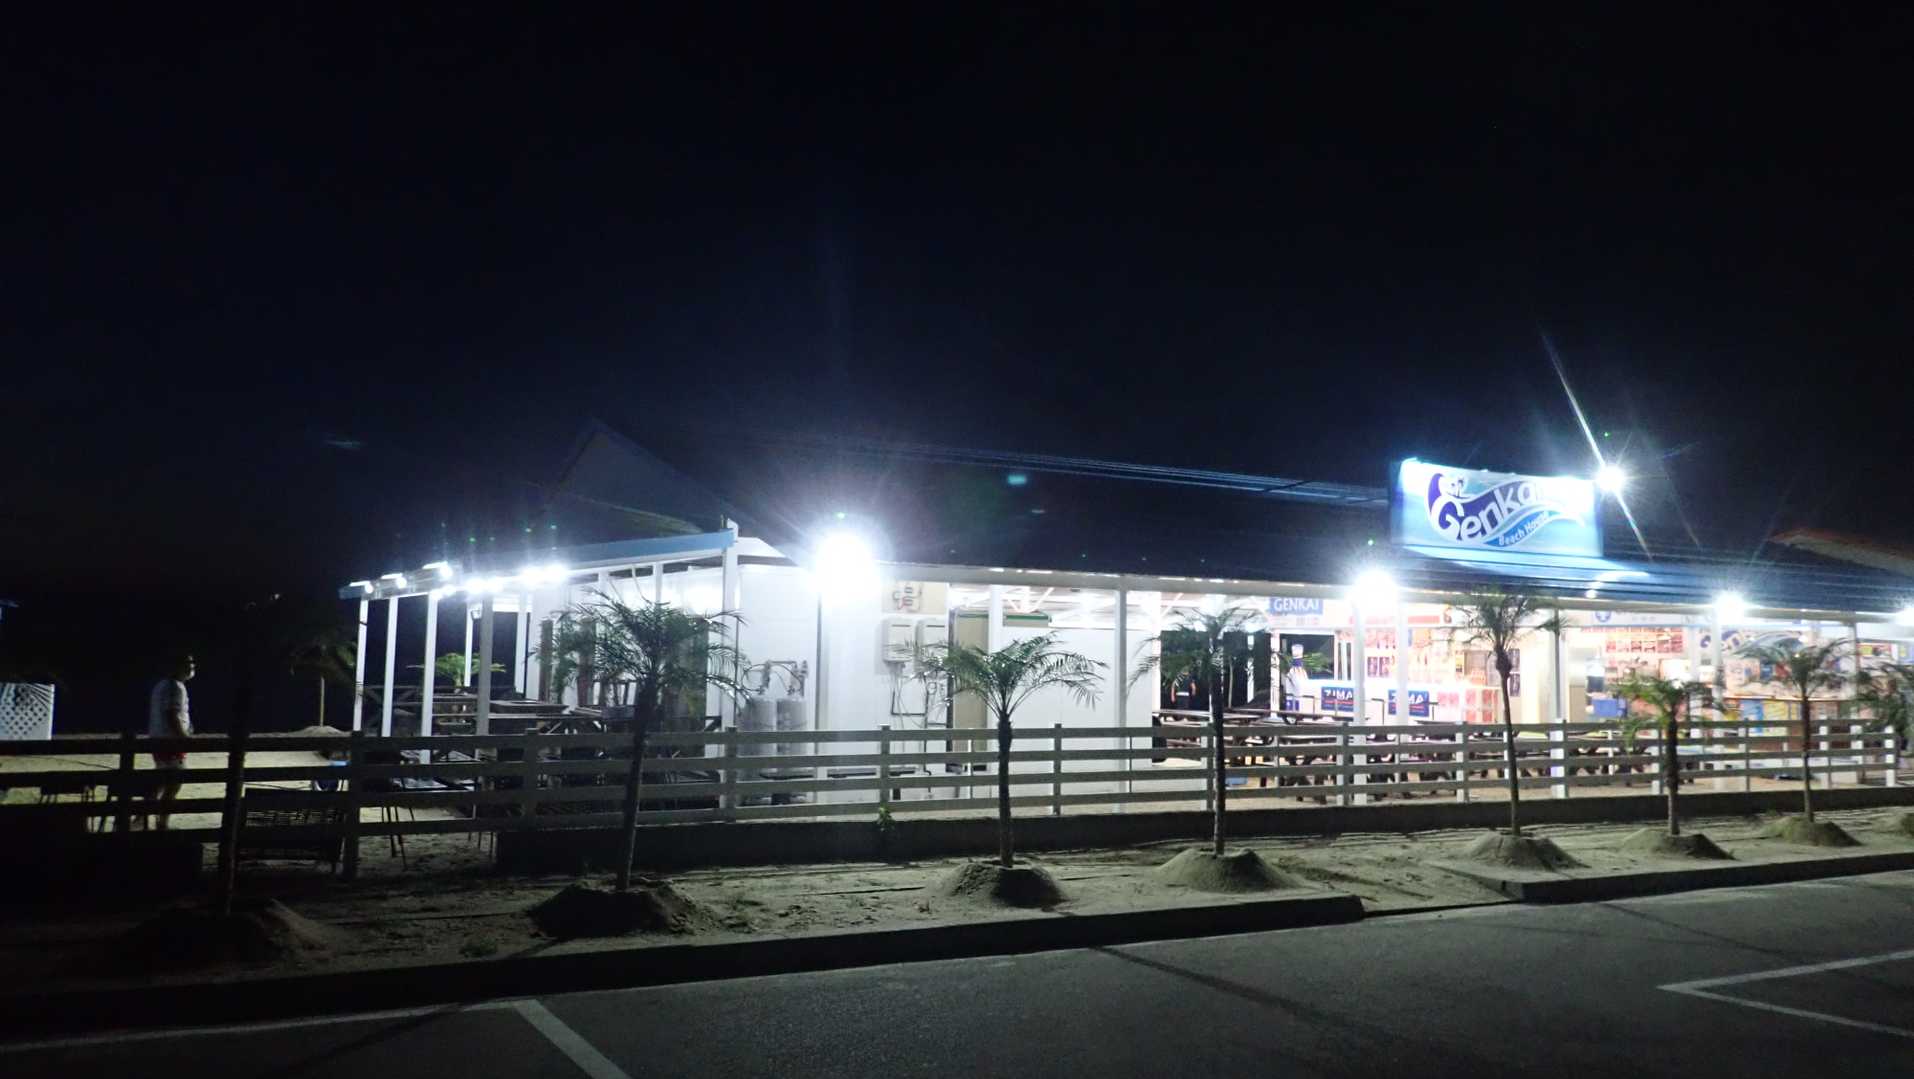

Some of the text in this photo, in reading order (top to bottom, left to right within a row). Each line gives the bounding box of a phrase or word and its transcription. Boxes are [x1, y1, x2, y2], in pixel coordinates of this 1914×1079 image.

[1431, 482, 1546, 541] Genka
[1499, 528, 1525, 545] Beach
[1274, 598, 1320, 611] GENKAI
[1391, 691, 1425, 704] ZMA
